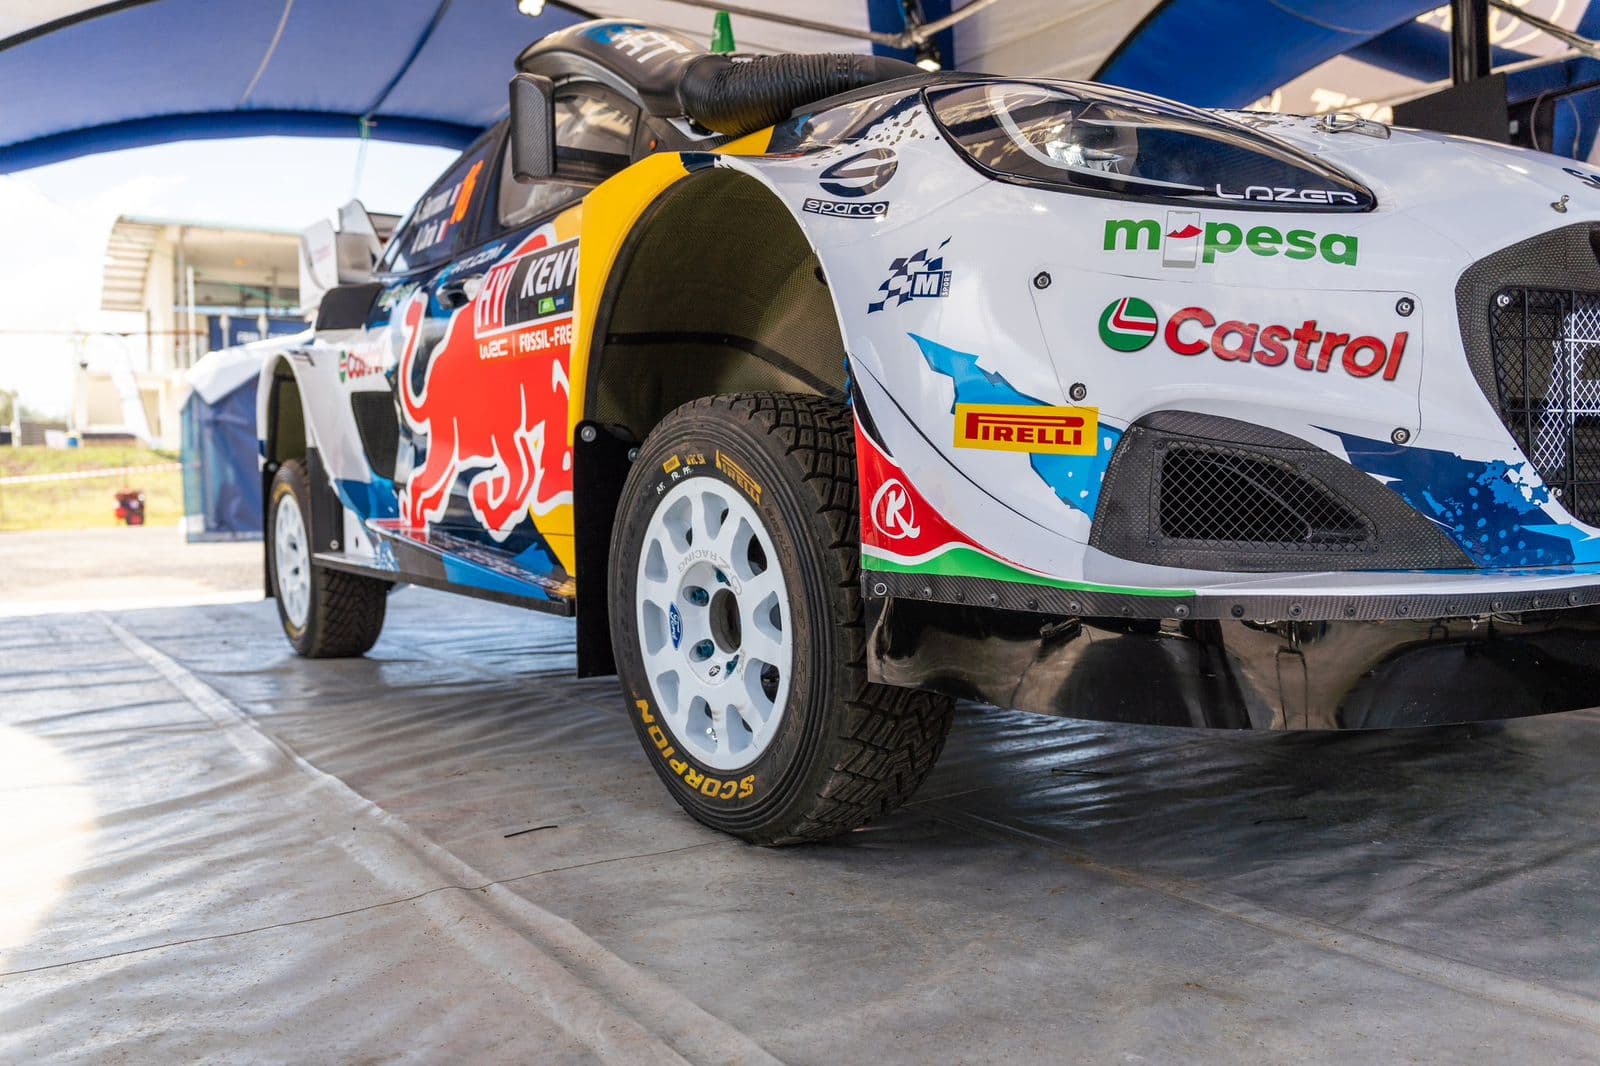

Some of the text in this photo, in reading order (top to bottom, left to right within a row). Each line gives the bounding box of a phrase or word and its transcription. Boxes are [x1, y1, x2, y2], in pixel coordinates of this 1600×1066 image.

[804, 199, 887, 216] sparco
[1216, 183, 1358, 205] LAZER
[1164, 306, 1409, 381] Castrol
[965, 411, 1085, 446] PIRELLI
[715, 449, 762, 506] PIRELLI
[635, 699, 756, 800] SCORPION
